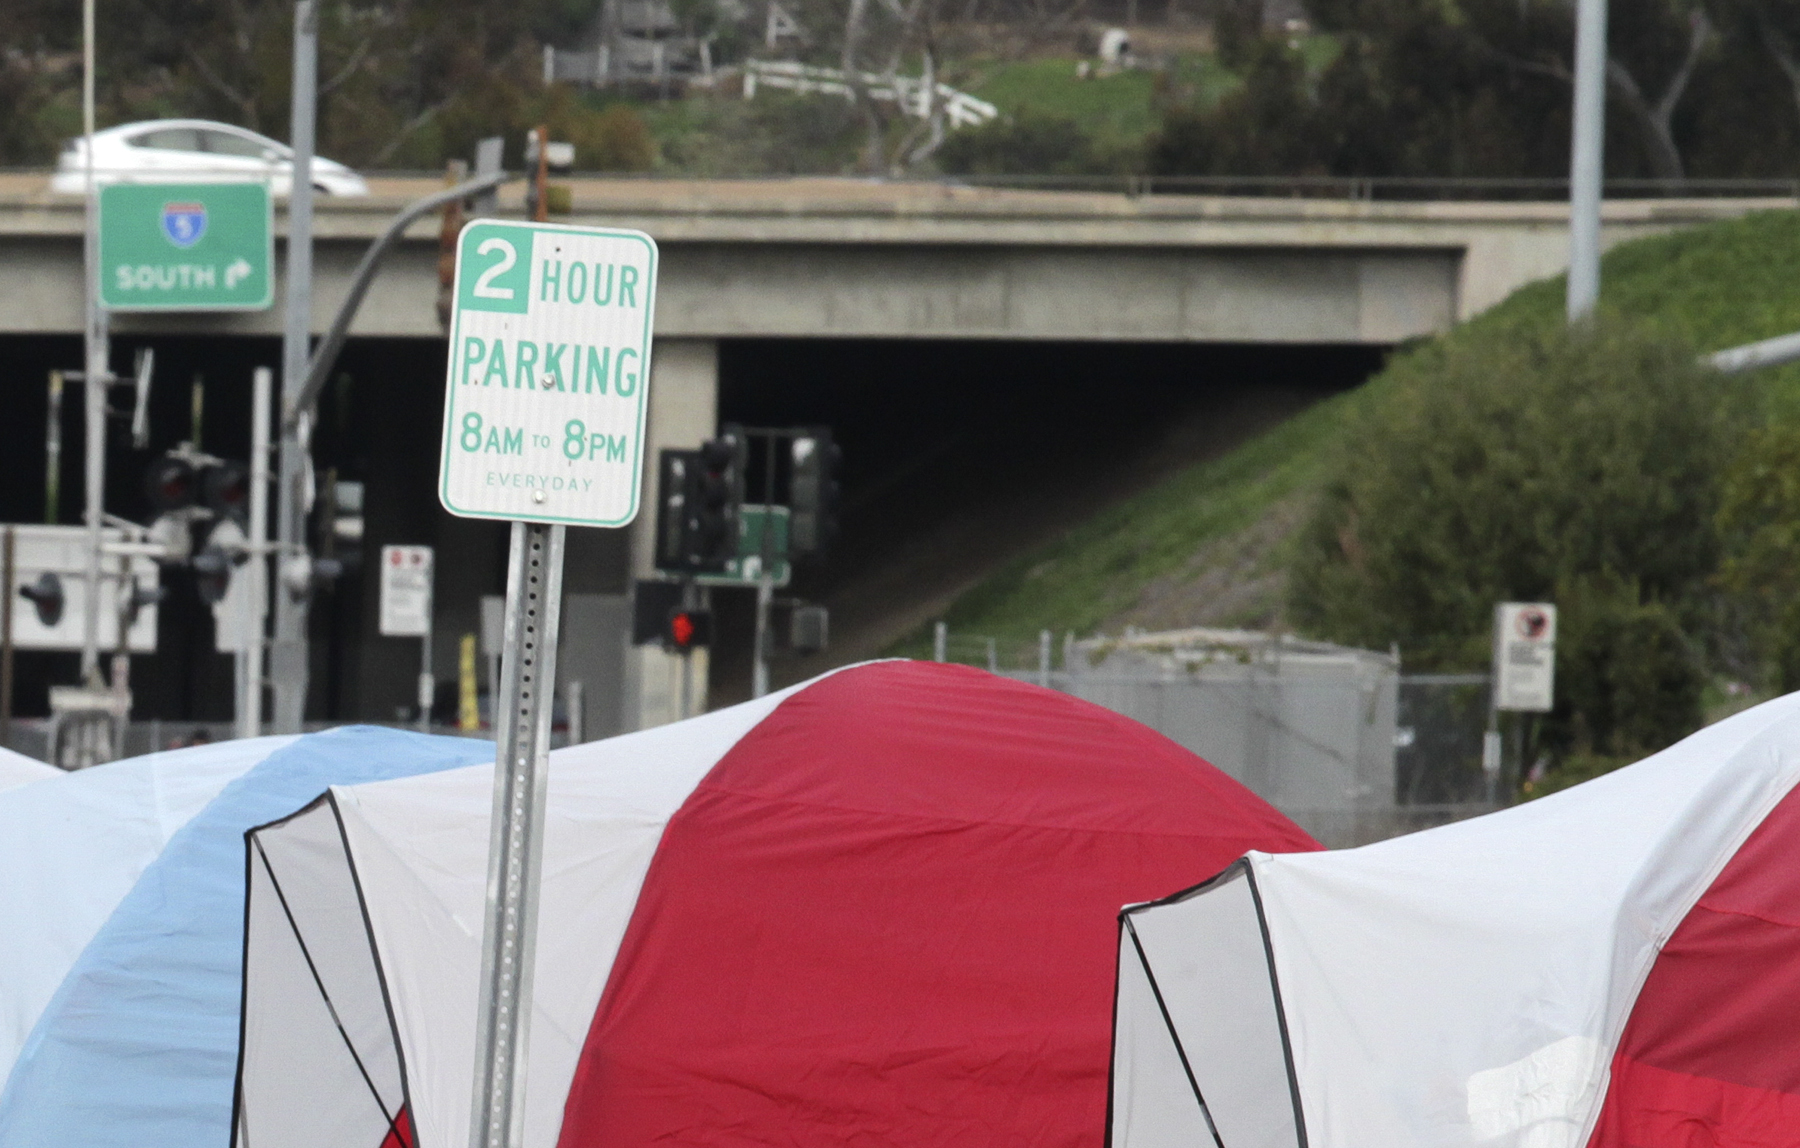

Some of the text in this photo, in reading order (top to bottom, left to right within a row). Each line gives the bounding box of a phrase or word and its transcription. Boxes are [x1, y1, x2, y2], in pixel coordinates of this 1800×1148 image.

[116, 264, 216, 290] SOUTH
[473, 237, 639, 308] 2 HOUR
[461, 336, 638, 398] PARKING
[532, 434, 551, 449] TO
[486, 471, 593, 492] EVERYDAY
